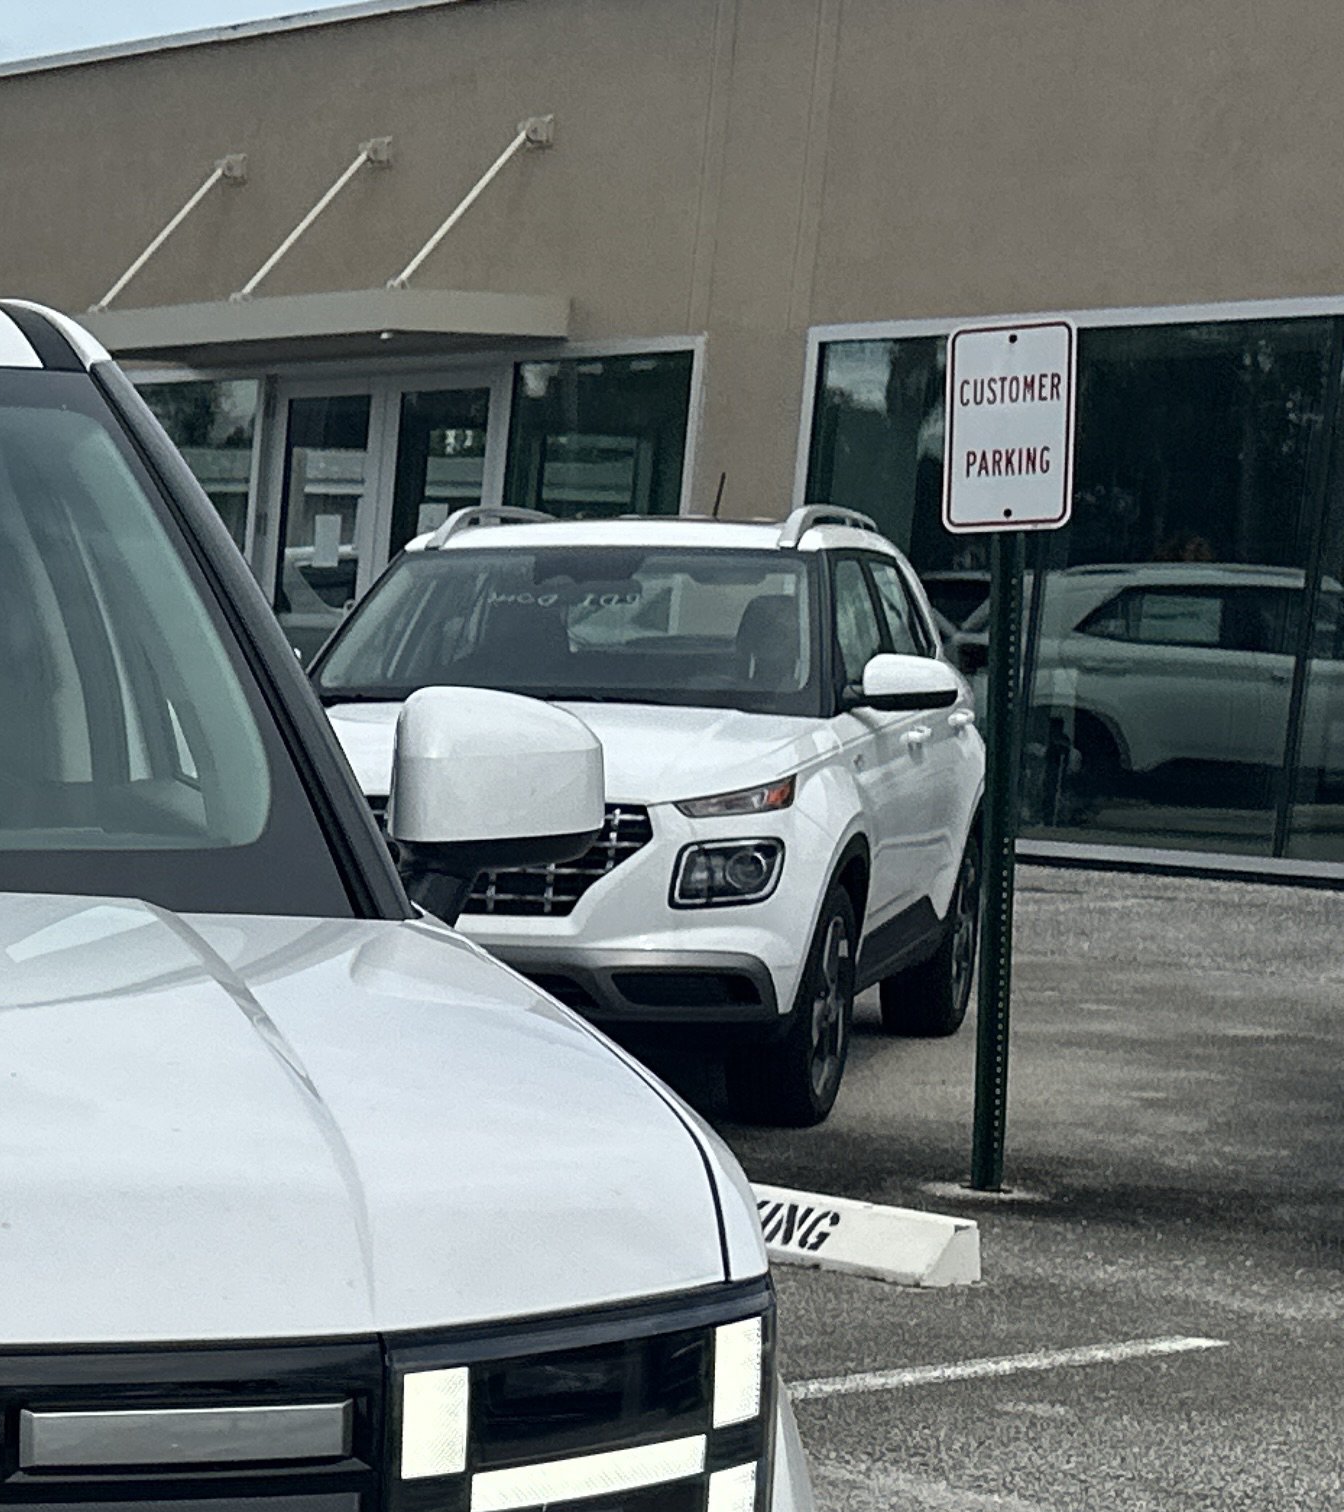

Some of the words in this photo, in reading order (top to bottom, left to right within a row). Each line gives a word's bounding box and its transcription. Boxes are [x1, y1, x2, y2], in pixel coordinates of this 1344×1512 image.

[960, 373, 1062, 407] CUSTOMER
[965, 446, 1051, 478] PARKING
[756, 1200, 841, 1252] ING
